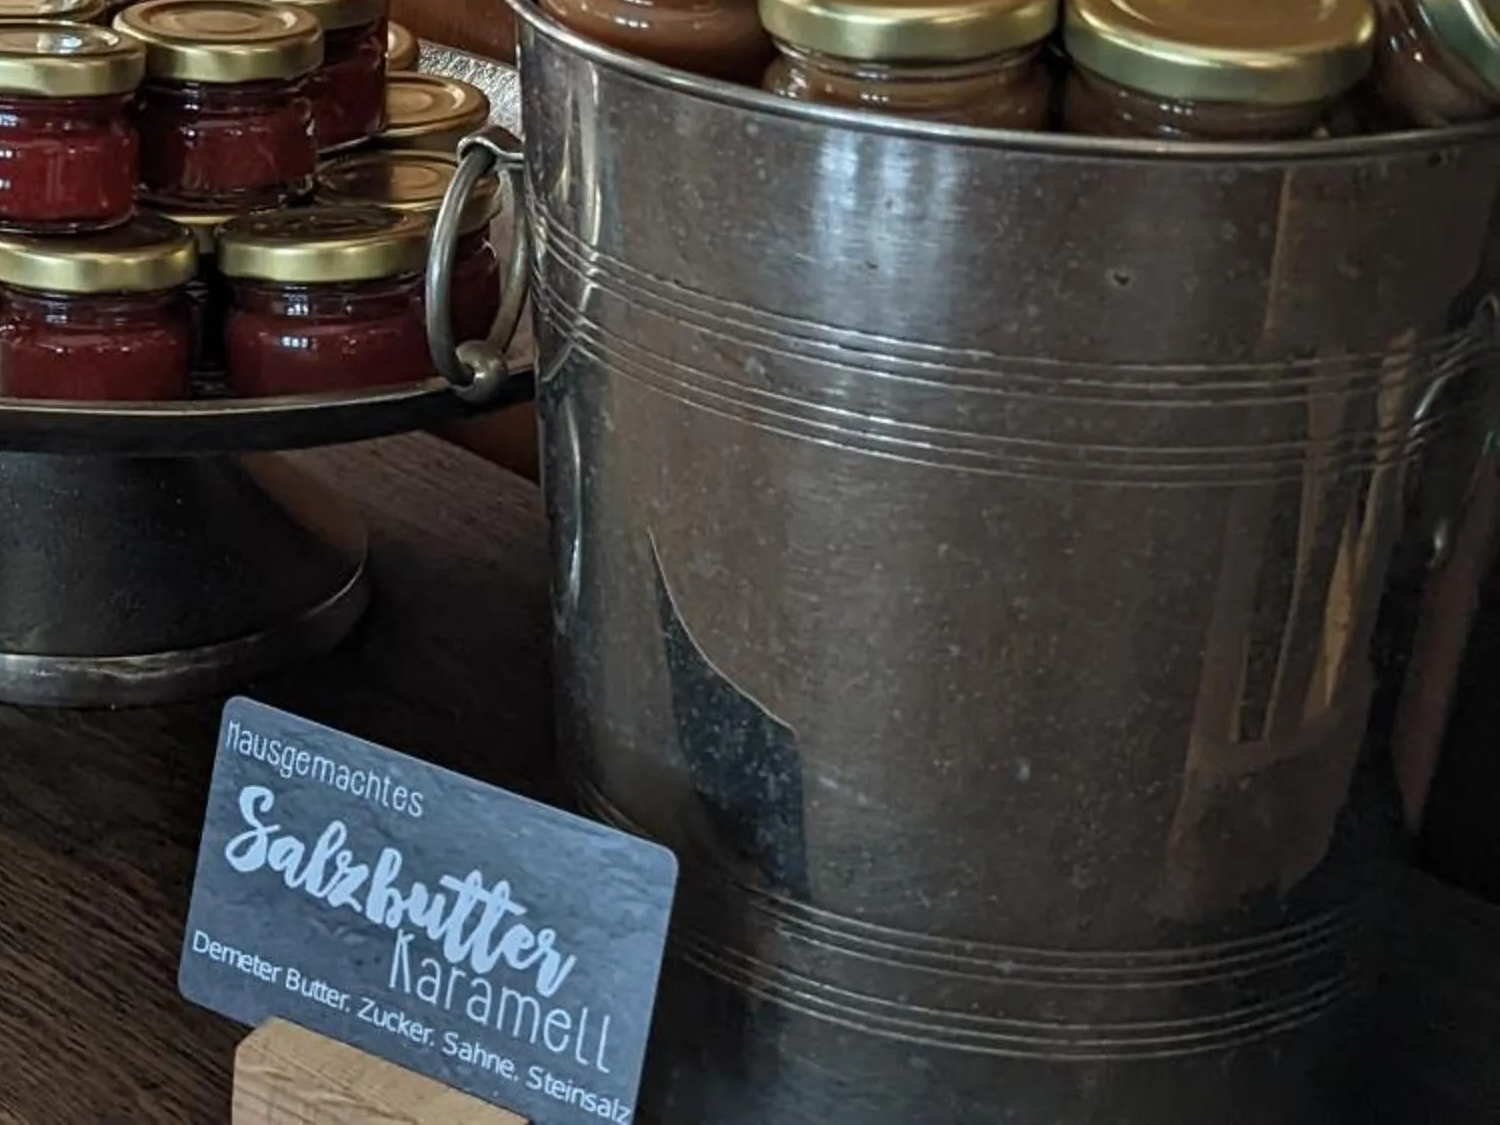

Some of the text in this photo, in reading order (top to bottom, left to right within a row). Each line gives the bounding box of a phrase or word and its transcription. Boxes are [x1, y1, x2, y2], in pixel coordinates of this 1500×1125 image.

[224, 785, 577, 997] Salzbutter
[192, 930, 282, 983] Demeter
[526, 1066, 631, 1125] Steinsalz
[389, 929, 611, 1073] Karamell
